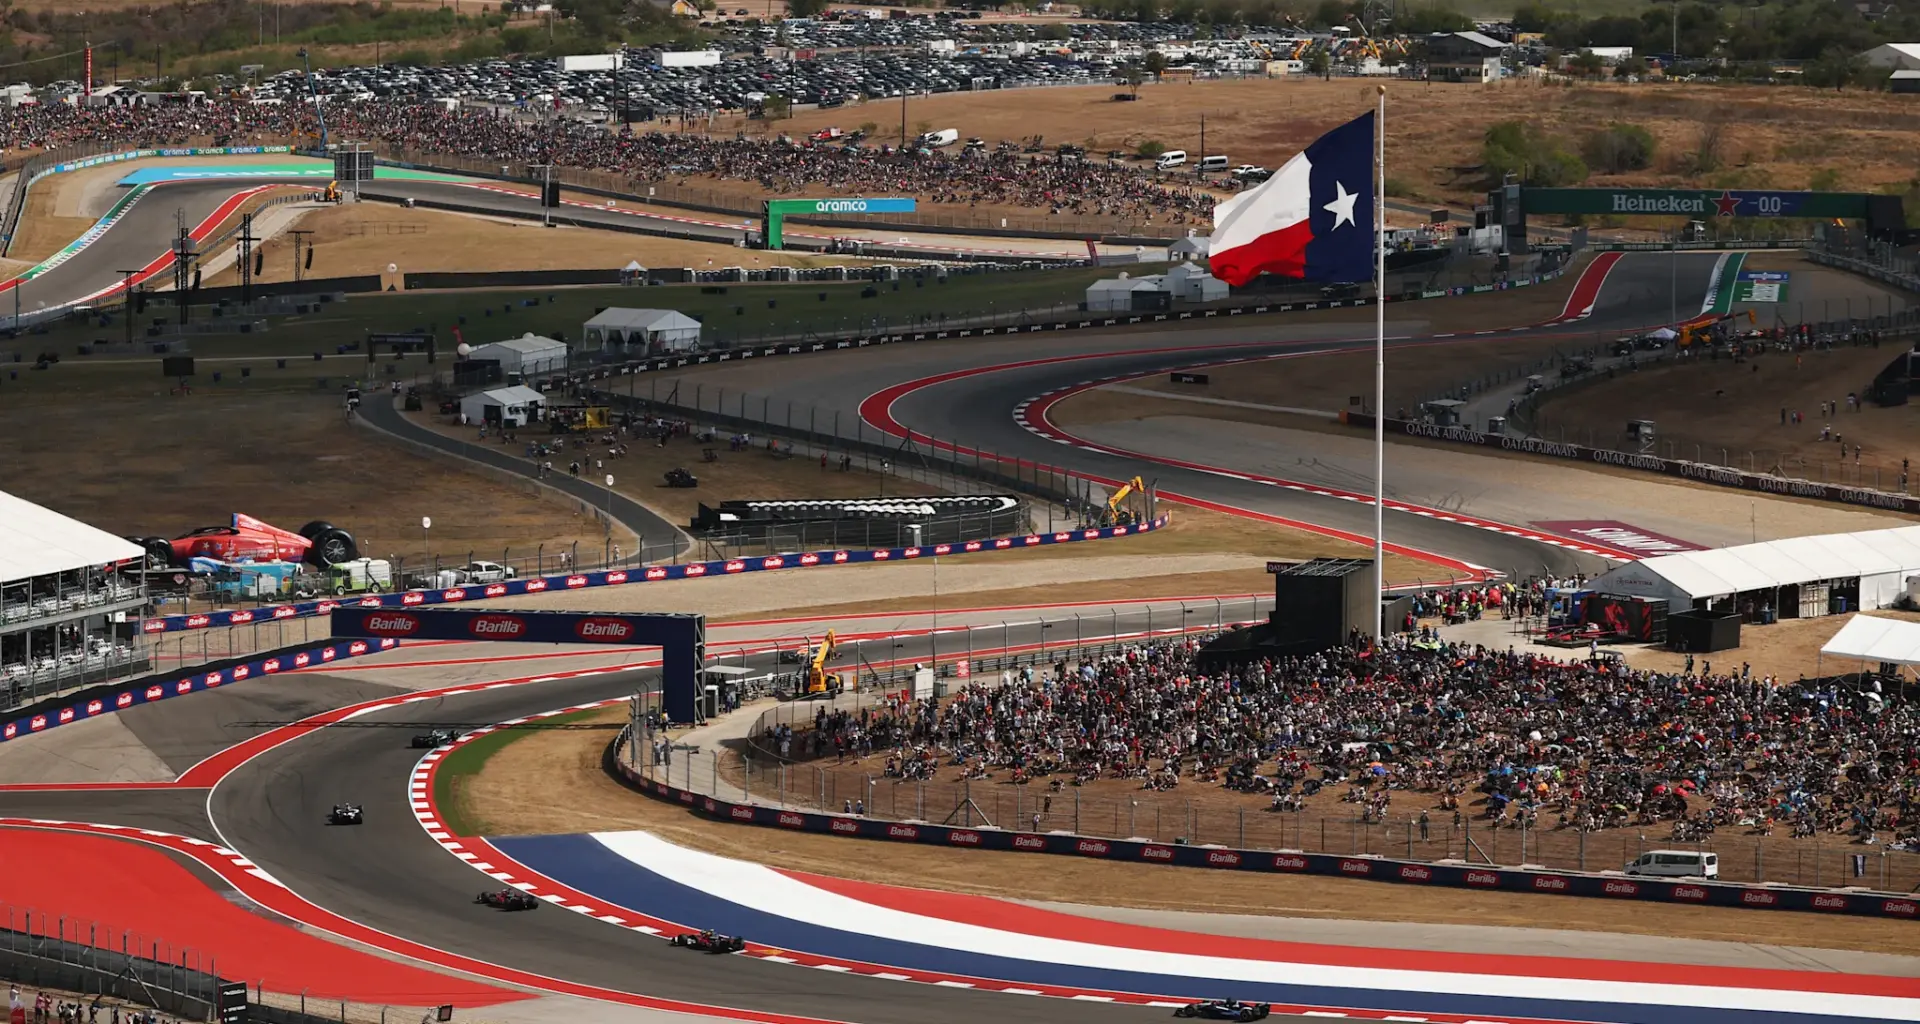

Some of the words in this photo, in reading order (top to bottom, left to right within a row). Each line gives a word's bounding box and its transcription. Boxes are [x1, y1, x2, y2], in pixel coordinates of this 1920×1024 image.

[816, 201, 867, 212] aramco
[1612, 194, 1704, 212] Heineken
[1406, 424, 1440, 438] QATAR
[1442, 428, 1484, 444] AIRWAYS
[1502, 437, 1534, 452] QATAR
[1536, 442, 1578, 458] AIRWAYS
[1594, 450, 1624, 464] QATAR
[1628, 456, 1666, 471] AIRWAYS
[1680, 464, 1706, 478] QATAR
[1710, 470, 1744, 486] AIRWAYS
[1759, 478, 1788, 492] QATAR
[1791, 483, 1826, 498] AIRWAYS
[1840, 490, 1868, 503] QATAR
[1871, 494, 1904, 509] AIRWAYS
[369, 616, 415, 630] Barilla
[476, 620, 522, 634] Barilla
[582, 622, 628, 636] Barilla
[832, 821, 857, 832] Barilla
[890, 826, 916, 837] Barilla
[951, 832, 978, 843] Barilla
[1016, 837, 1043, 848] Barilla
[1079, 842, 1107, 854] Barilla
[1144, 848, 1172, 859] Barilla
[1210, 852, 1238, 864] Barilla
[1276, 857, 1304, 868] Barilla
[1342, 862, 1370, 873] Barilla
[1402, 868, 1429, 879] Barilla
[1468, 873, 1496, 884] Barilla
[1536, 878, 1565, 890] Barilla
[1606, 883, 1635, 894] Barilla
[1675, 888, 1704, 898] Barilla
[1744, 893, 1774, 904] Barilla
[1814, 898, 1844, 908] Barilla
[1885, 902, 1916, 914] Barilla
